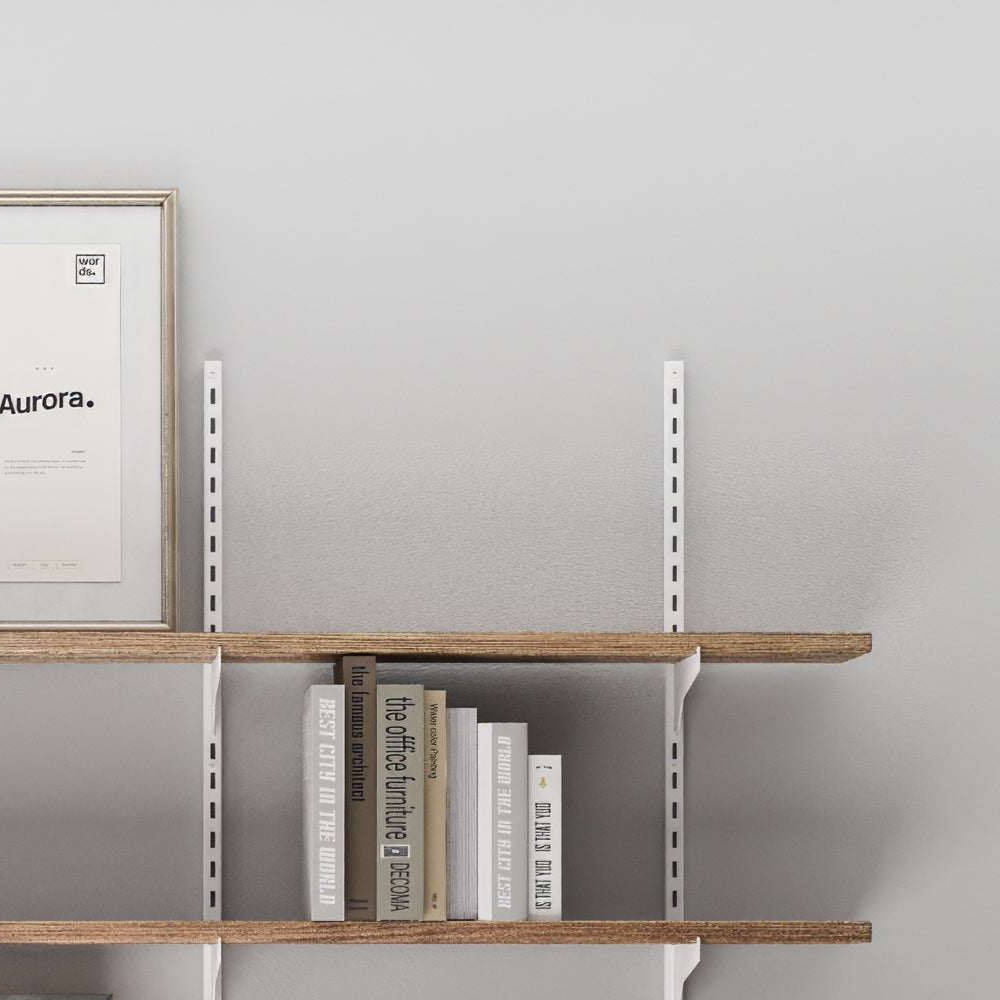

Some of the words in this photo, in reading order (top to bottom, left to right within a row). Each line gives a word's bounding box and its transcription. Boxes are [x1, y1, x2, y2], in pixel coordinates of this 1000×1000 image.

[352, 665, 369, 686] the
[319, 697, 336, 741] BEST
[352, 691, 369, 738] famous
[385, 696, 414, 722] the
[319, 743, 336, 783] CITY
[319, 786, 336, 804] IN
[385, 775, 416, 840] furniture
[319, 809, 336, 842] THE
[535, 822, 552, 841] THAT
[535, 844, 552, 852] IS
[319, 846, 336, 906] WORLD
[389, 862, 410, 912] DECOMA
[535, 879, 552, 899] THAT
[535, 901, 552, 910] IS
